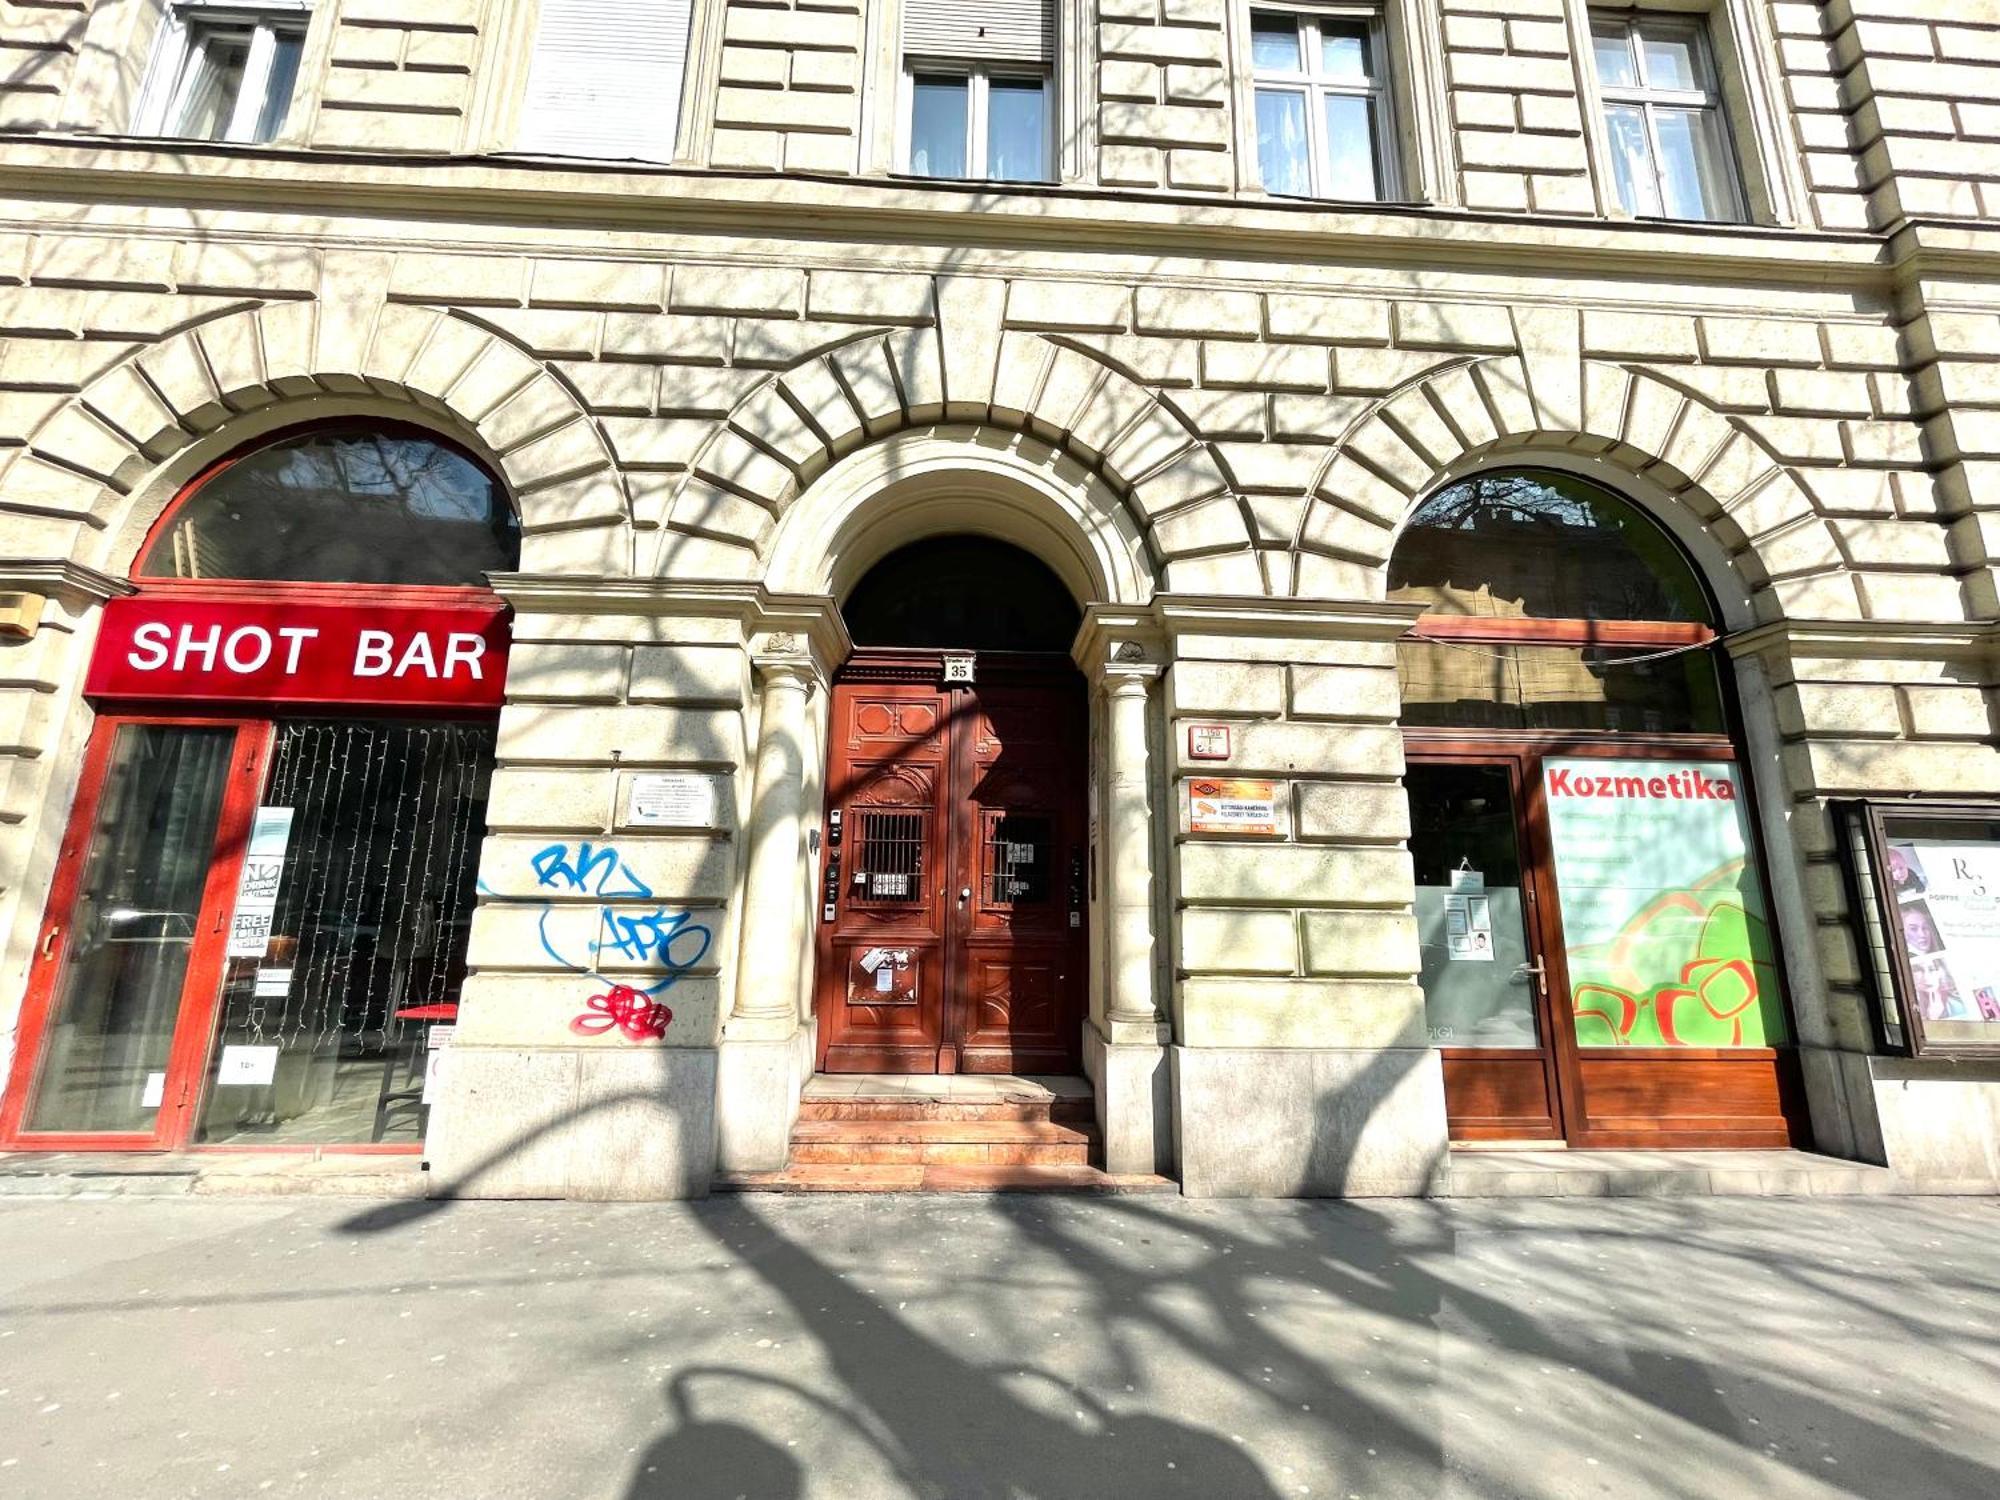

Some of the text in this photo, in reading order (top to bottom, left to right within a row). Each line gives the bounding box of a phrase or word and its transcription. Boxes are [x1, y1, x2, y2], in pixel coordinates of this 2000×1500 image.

[127, 622, 486, 680] SHOT BAR
[951, 665, 967, 678] 35
[1548, 768, 1736, 801] Kozmetika
[244, 878, 278, 891] DRINK
[234, 914, 271, 929] FREE
